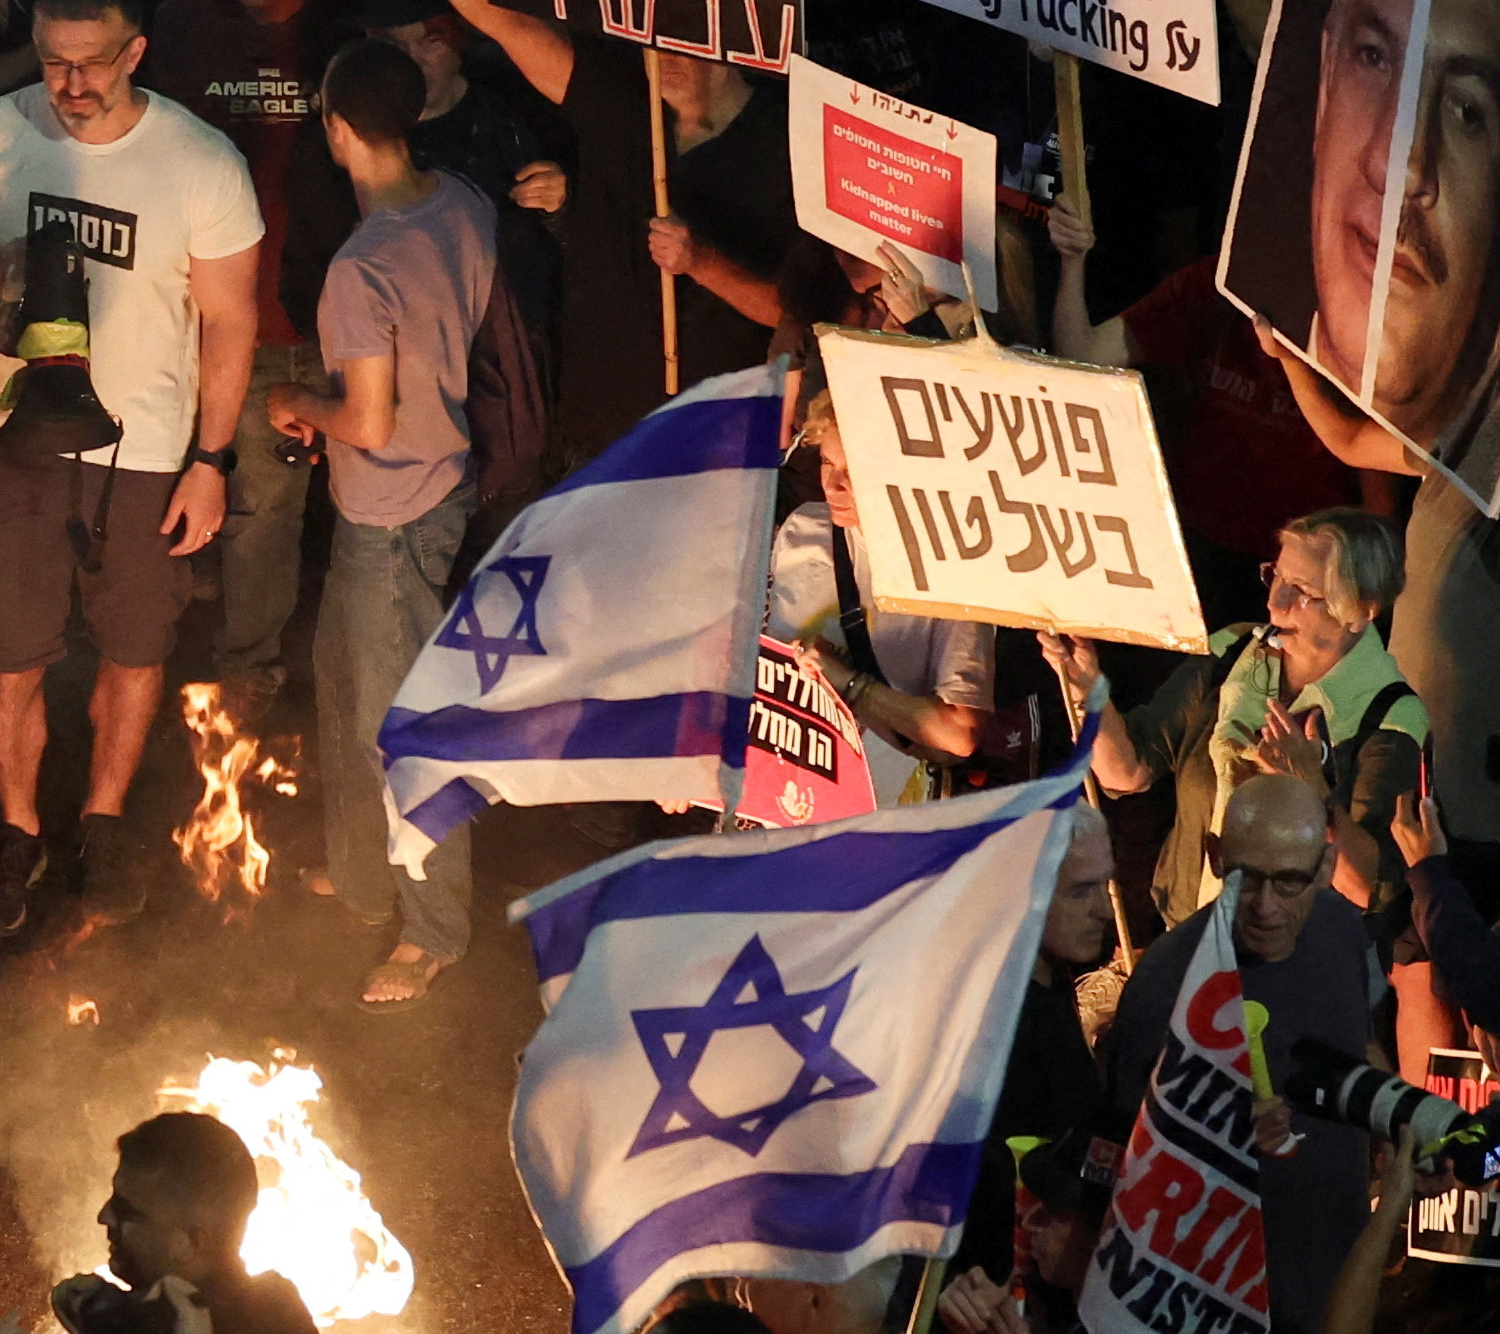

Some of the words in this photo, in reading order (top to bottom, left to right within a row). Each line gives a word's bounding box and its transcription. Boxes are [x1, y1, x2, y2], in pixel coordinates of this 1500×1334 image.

[1165, 19, 1201, 72] על
[205, 81, 304, 98] AMERIC
[229, 98, 310, 115] EAGLE
[872, 92, 934, 125] נתניהו
[866, 156, 914, 186] חשובים
[882, 146, 931, 174] חטופות
[840, 177, 909, 219] Kidnapped
[910, 208, 945, 230] lives
[868, 210, 913, 236] matter
[886, 471, 1155, 592] בשלטון
[749, 700, 802, 759] מחל
[807, 726, 834, 772] הן
